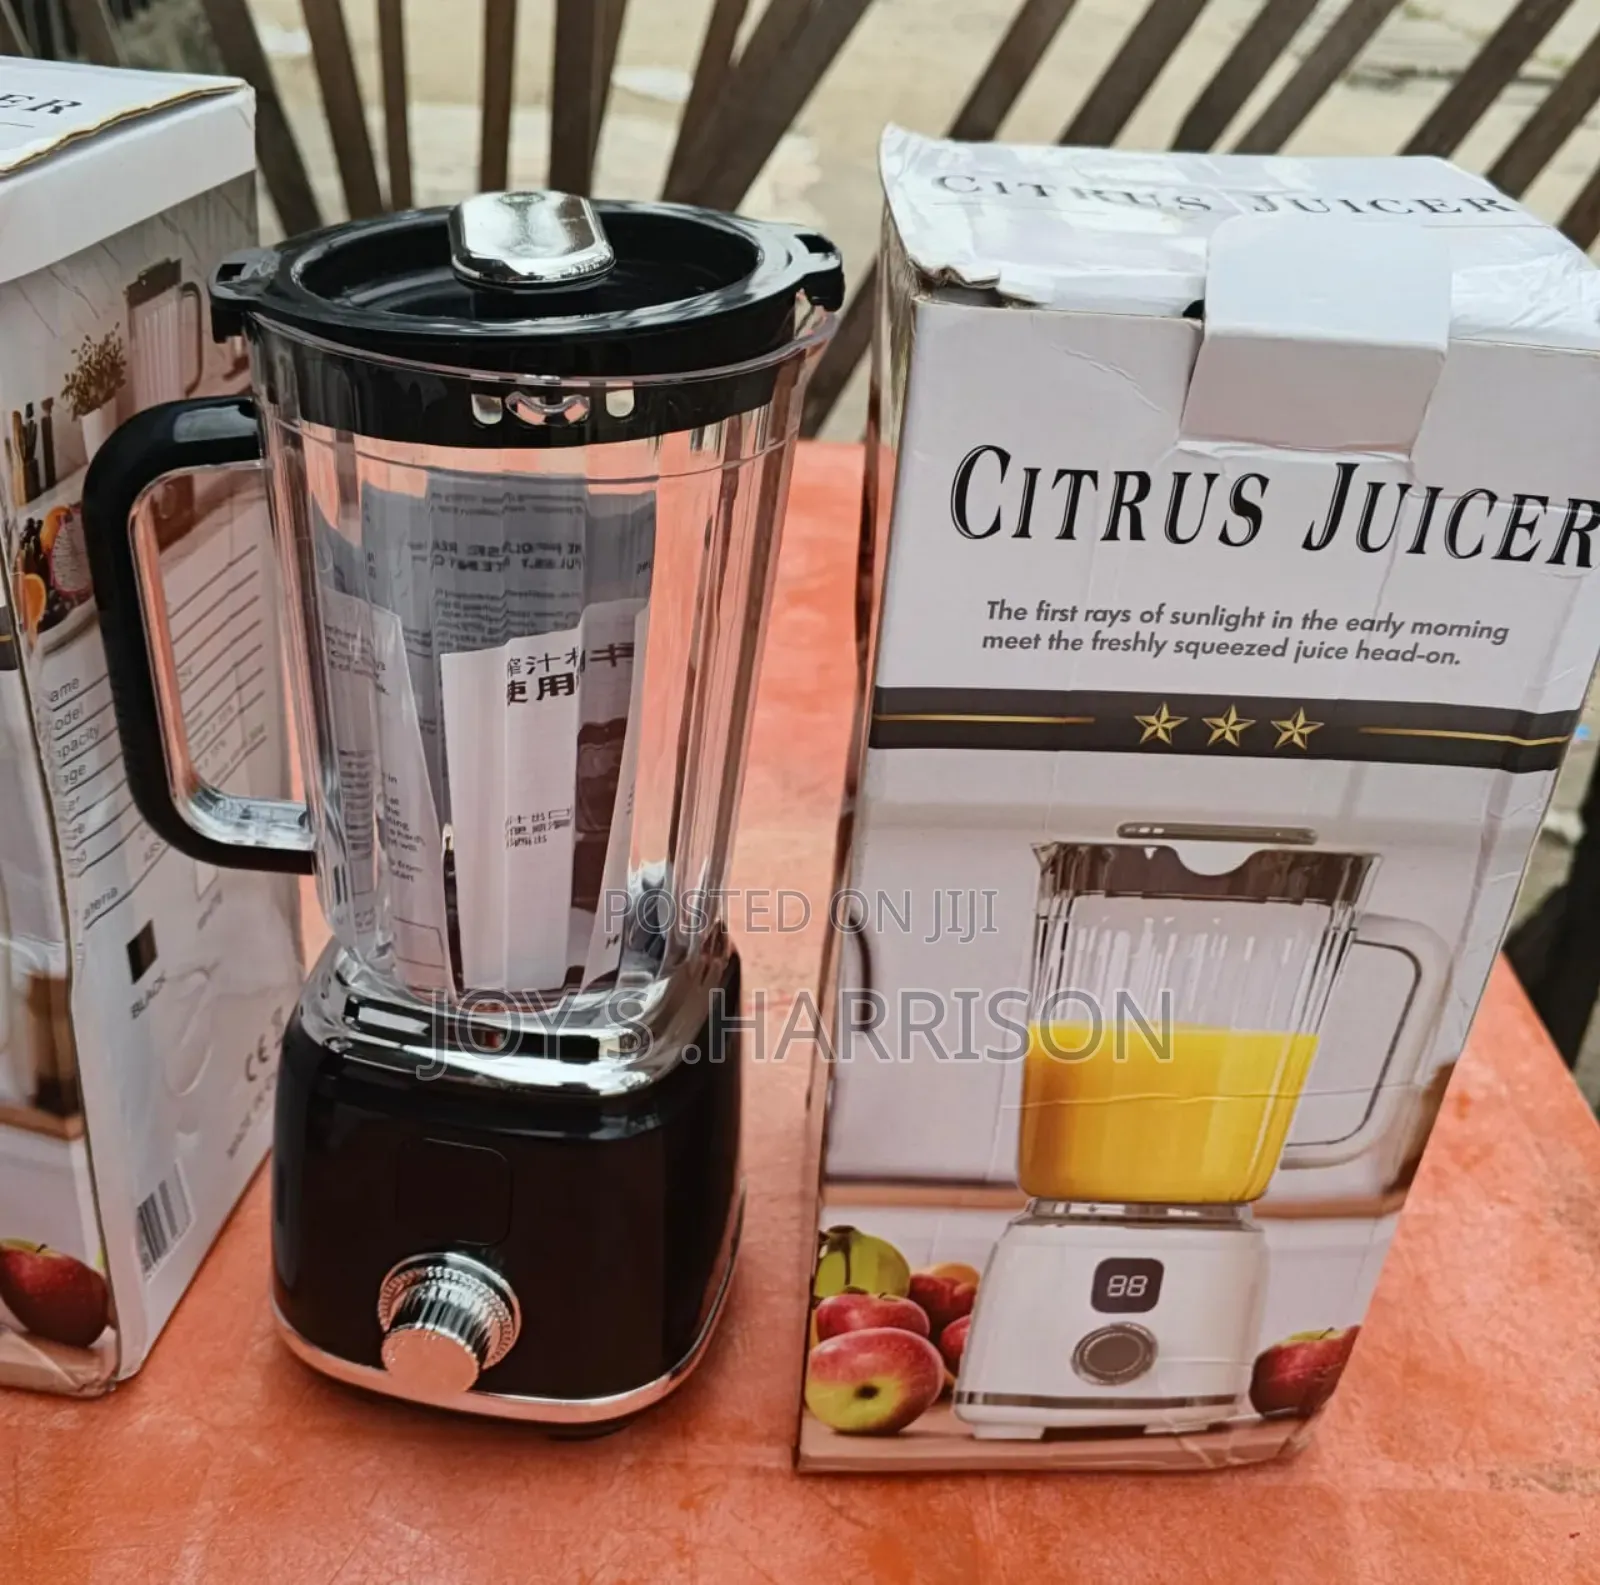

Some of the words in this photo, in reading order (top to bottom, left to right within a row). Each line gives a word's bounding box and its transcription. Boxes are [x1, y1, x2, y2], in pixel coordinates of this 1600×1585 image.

[1250, 194, 1519, 216] JUICER
[950, 444, 1270, 548] CITRUS
[1301, 461, 1600, 569] JUICER
[986, 599, 1028, 622] The
[1035, 599, 1079, 623] first
[1084, 607, 1131, 628] rays
[1139, 602, 1167, 624] of
[1169, 604, 1266, 633] sunlight
[1271, 610, 1293, 630] in
[1300, 609, 1338, 631] the
[1345, 611, 1406, 639] early
[1410, 619, 1510, 646] morning
[982, 632, 1042, 650] meet
[1047, 629, 1084, 652] the
[1091, 629, 1168, 659] freshly
[1173, 636, 1289, 660] squeezed
[1293, 639, 1349, 664] juice
[1355, 639, 1461, 666] head-on.
[1107, 1275, 1149, 1297] 88
